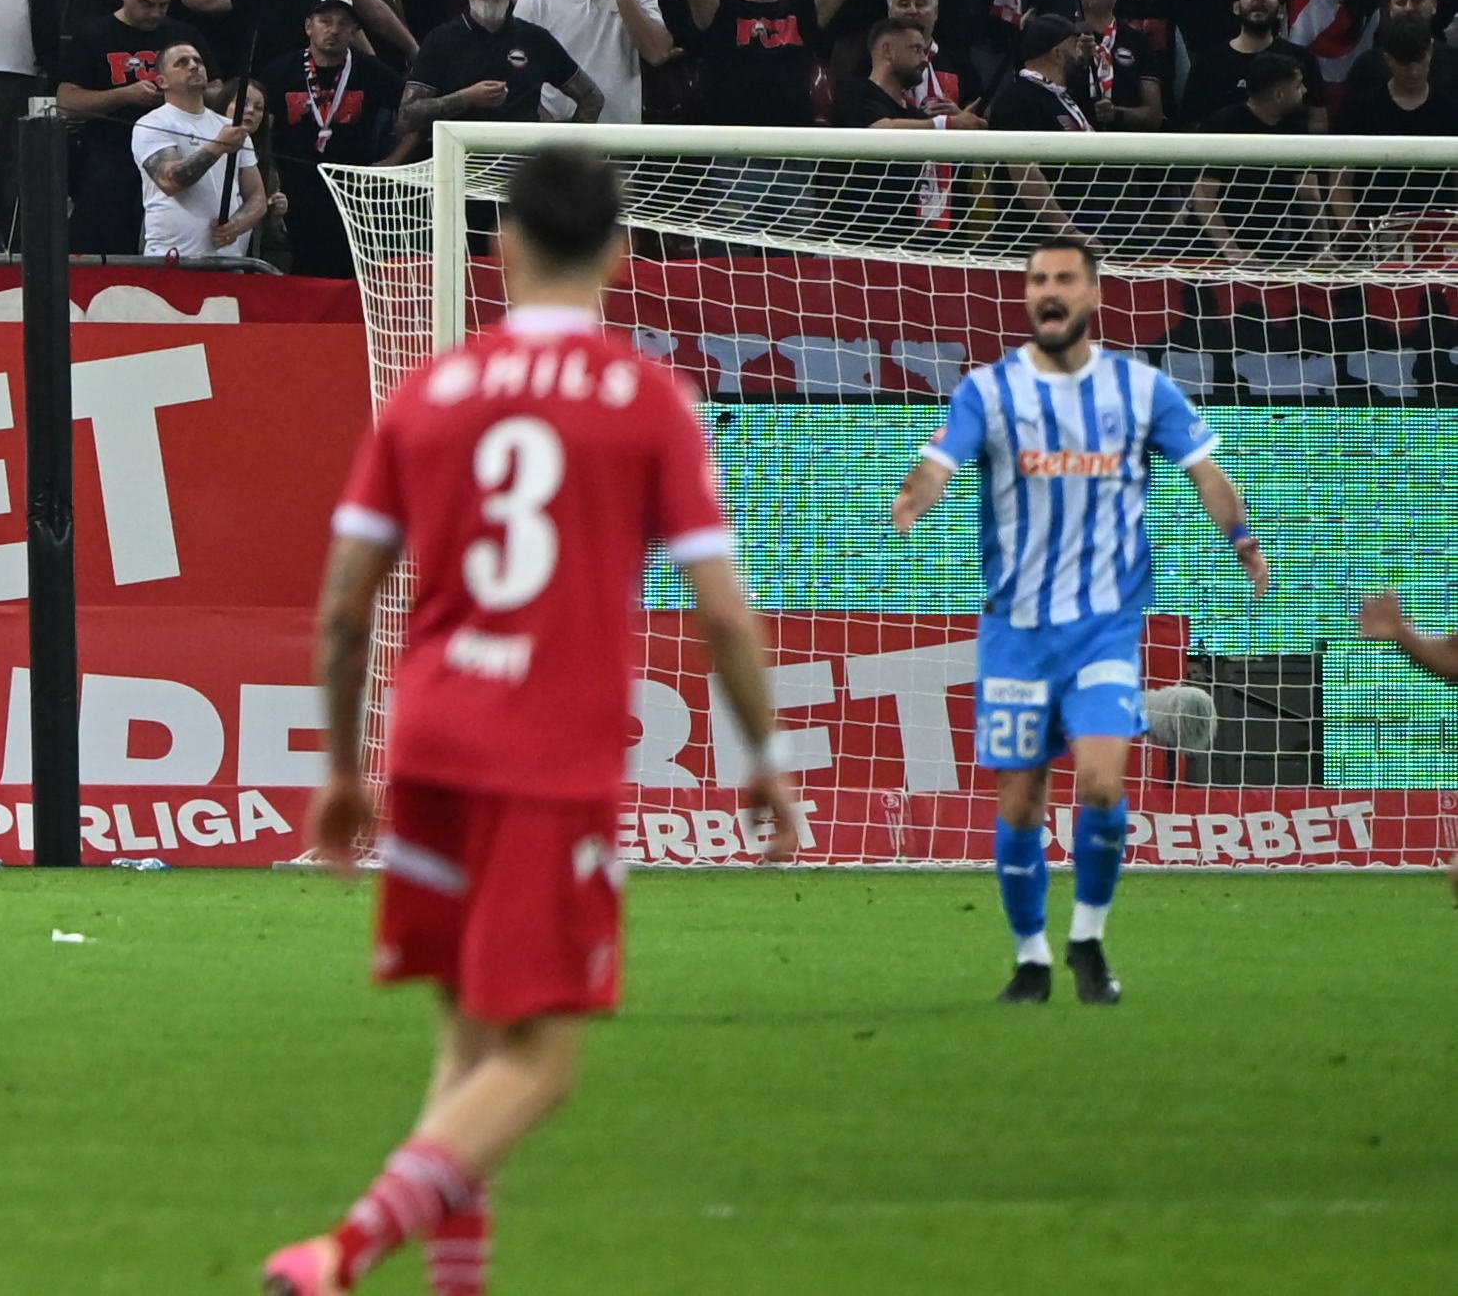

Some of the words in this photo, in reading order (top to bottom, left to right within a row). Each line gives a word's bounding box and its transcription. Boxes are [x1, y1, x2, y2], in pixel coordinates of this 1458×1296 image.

[1020, 449, 1128, 479] Betano
[460, 415, 564, 615] 3
[989, 708, 1040, 758] 26
